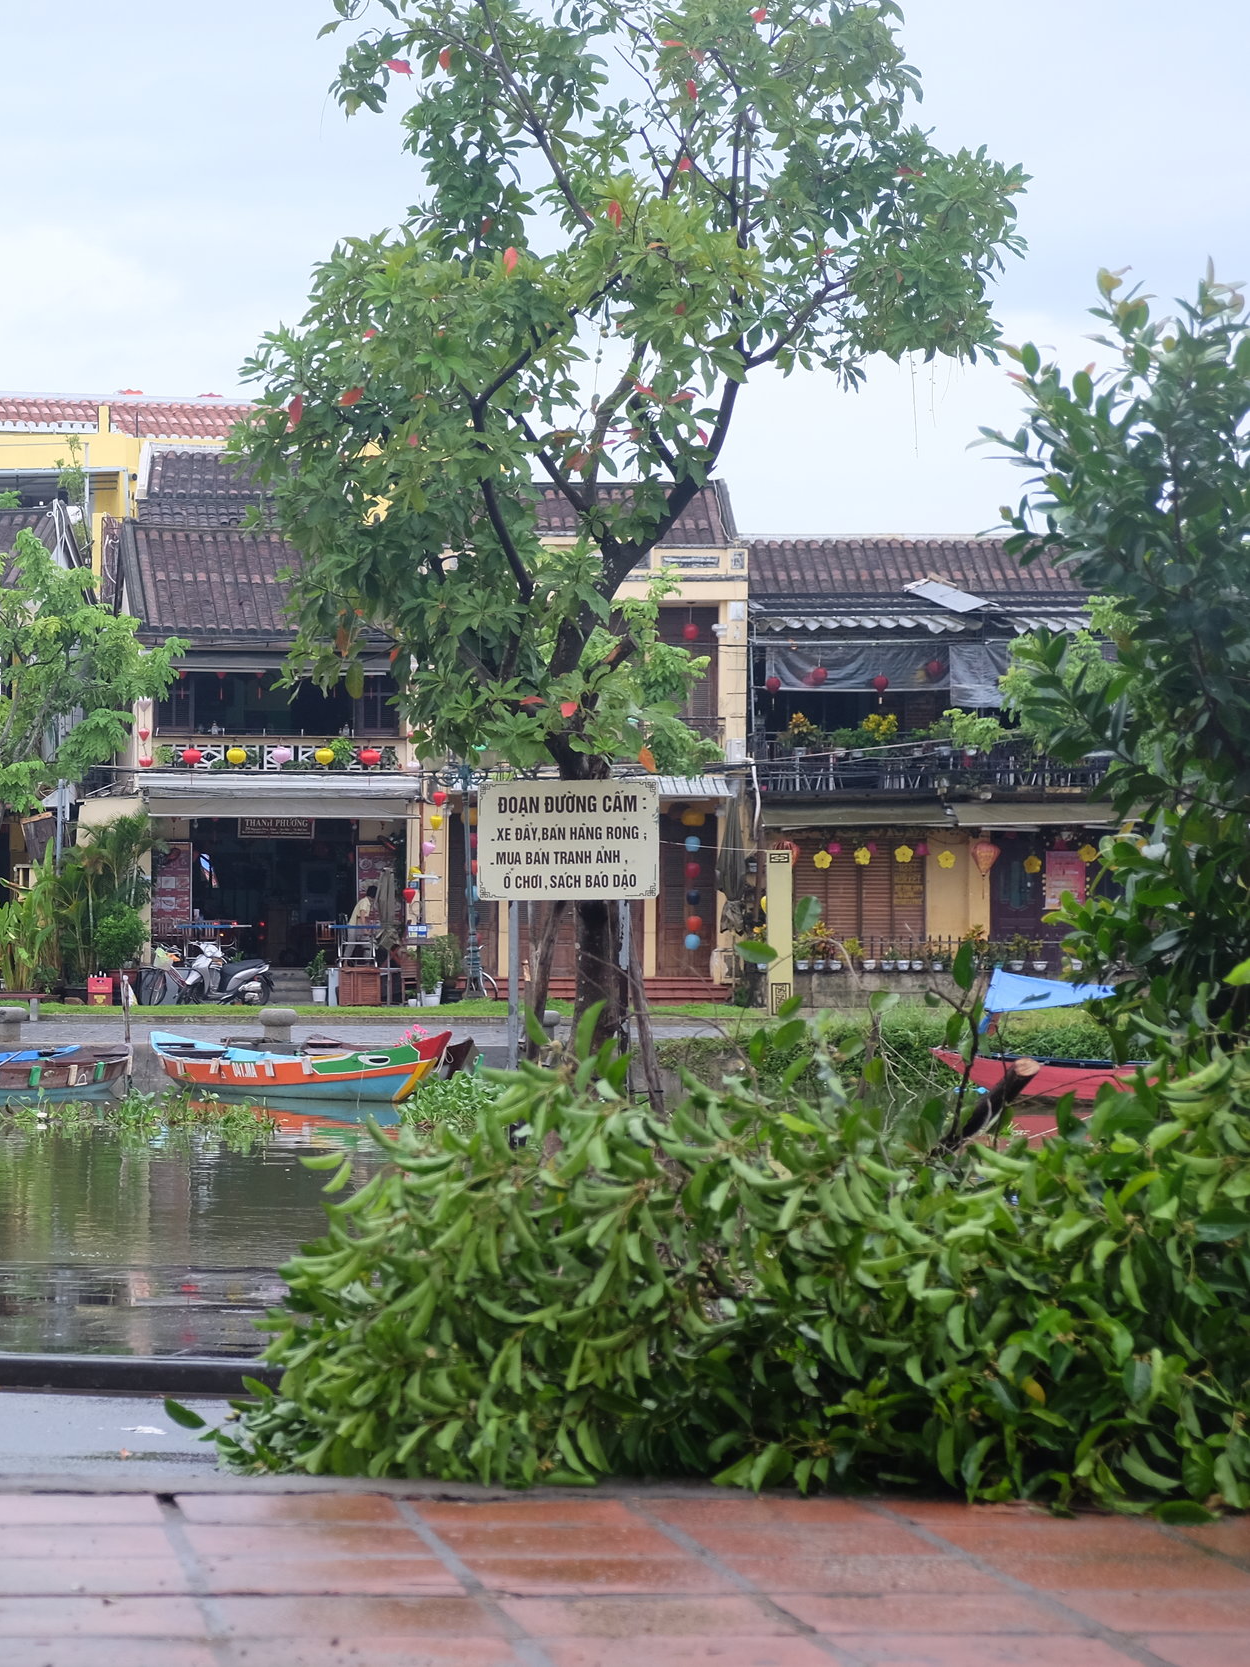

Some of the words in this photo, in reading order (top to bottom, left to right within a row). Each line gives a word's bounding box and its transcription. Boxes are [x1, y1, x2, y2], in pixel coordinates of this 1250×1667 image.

[498, 796, 540, 817] ĐOẠN
[544, 790, 597, 813] ĐƯỜNG
[569, 822, 602, 840] HÀNG
[525, 847, 549, 865] BÁN
[553, 850, 592, 865] TRANH
[585, 870, 609, 888] BÁO
[613, 873, 637, 891] DẠO
